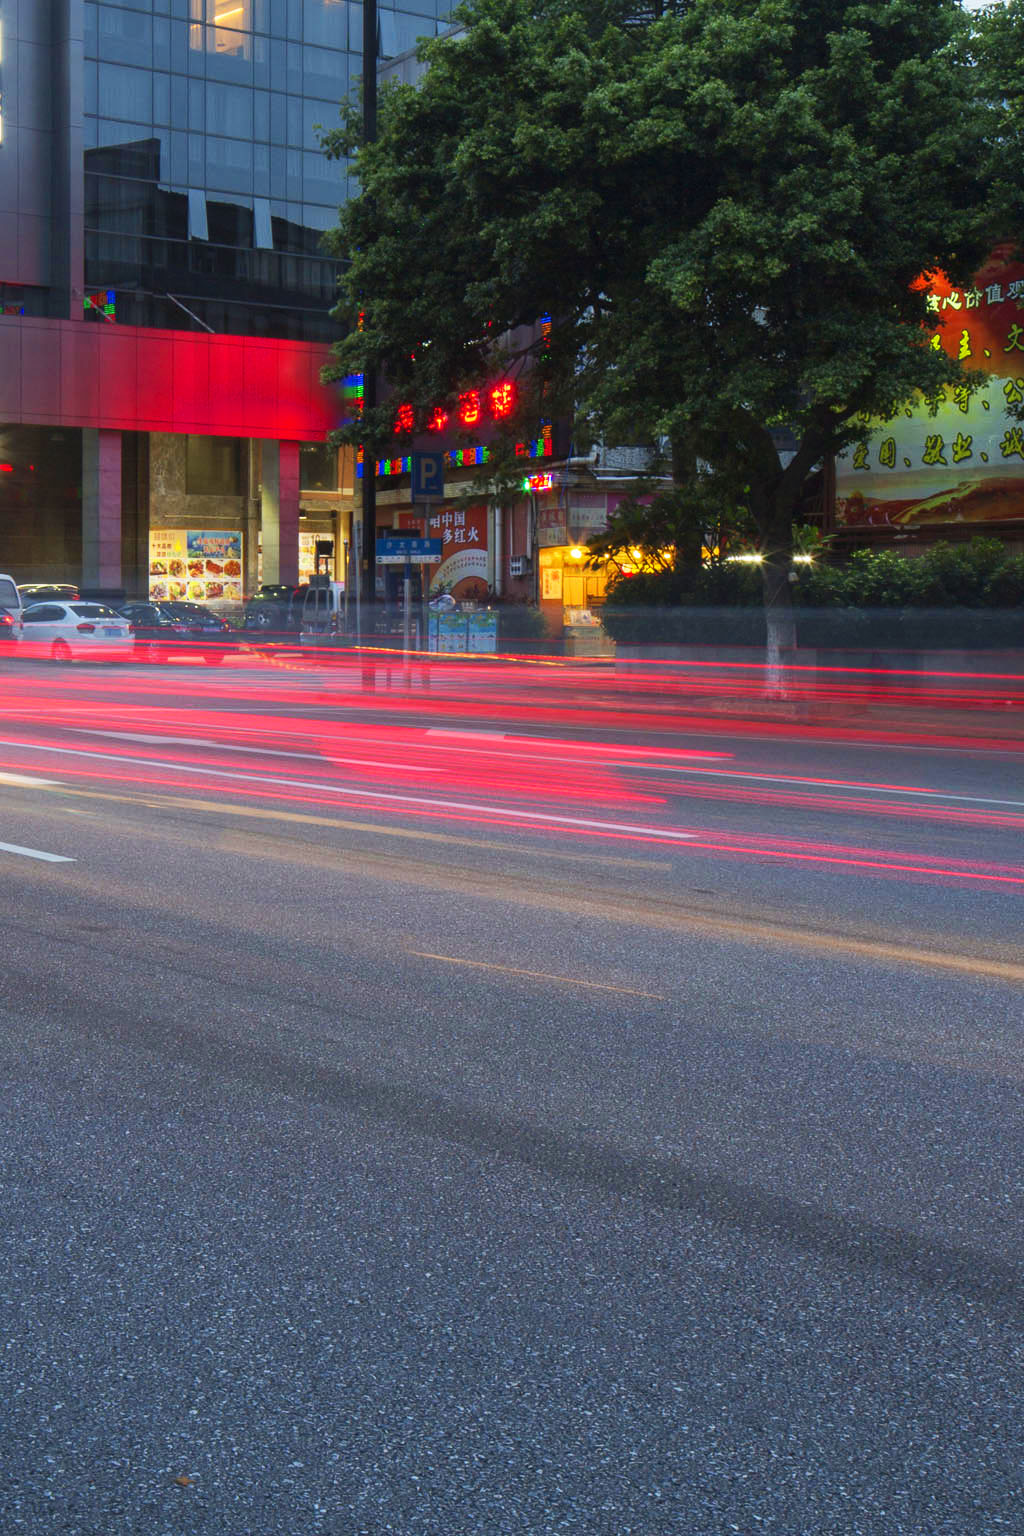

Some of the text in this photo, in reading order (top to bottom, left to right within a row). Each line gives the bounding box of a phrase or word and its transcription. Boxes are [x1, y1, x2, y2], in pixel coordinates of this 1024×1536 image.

[421, 457, 438, 490] P
[442, 526, 480, 545] 多红火
